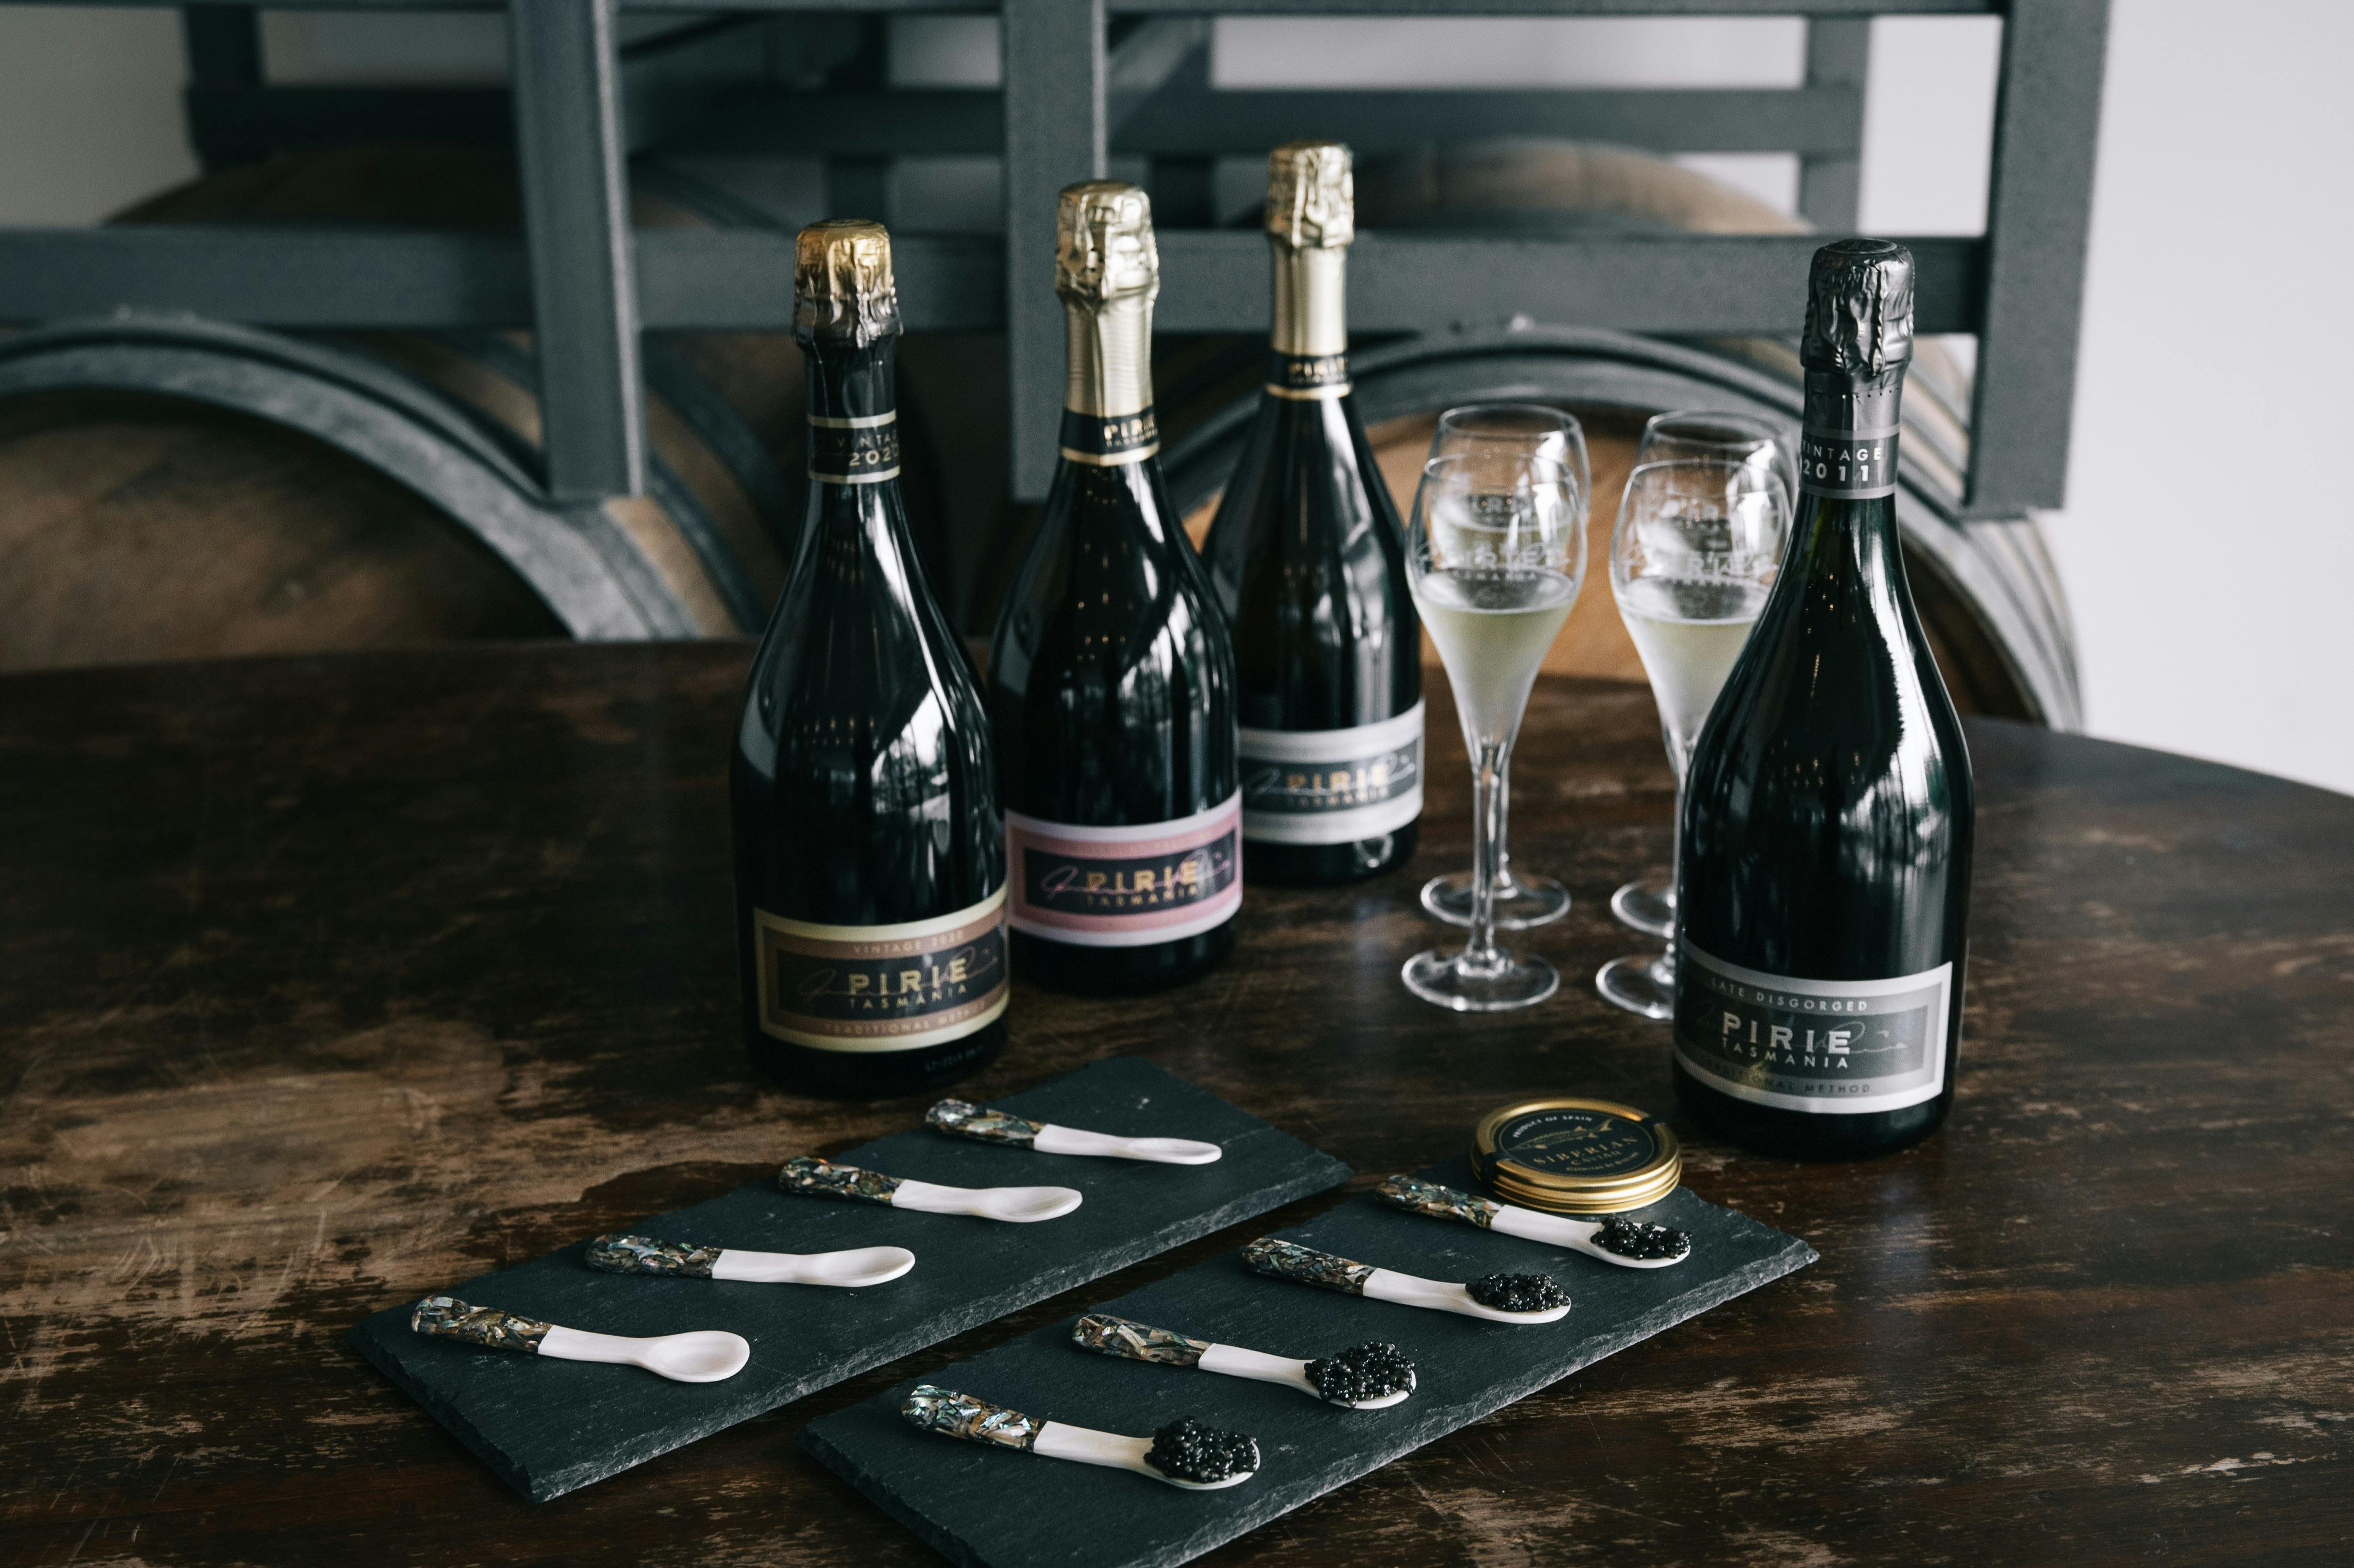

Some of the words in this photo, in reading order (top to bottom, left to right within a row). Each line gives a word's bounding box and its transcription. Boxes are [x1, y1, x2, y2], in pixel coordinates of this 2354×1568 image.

[1803, 458, 1869, 482] 2011
[1086, 860, 1198, 892] PIRIE
[849, 958, 967, 996] PIRIE
[849, 984, 967, 1009] TASMANIA
[1756, 992, 1868, 1012] DISGORGED
[1723, 1011, 1851, 1055] PIRIE
[1722, 1036, 1848, 1068] TASMANIA
